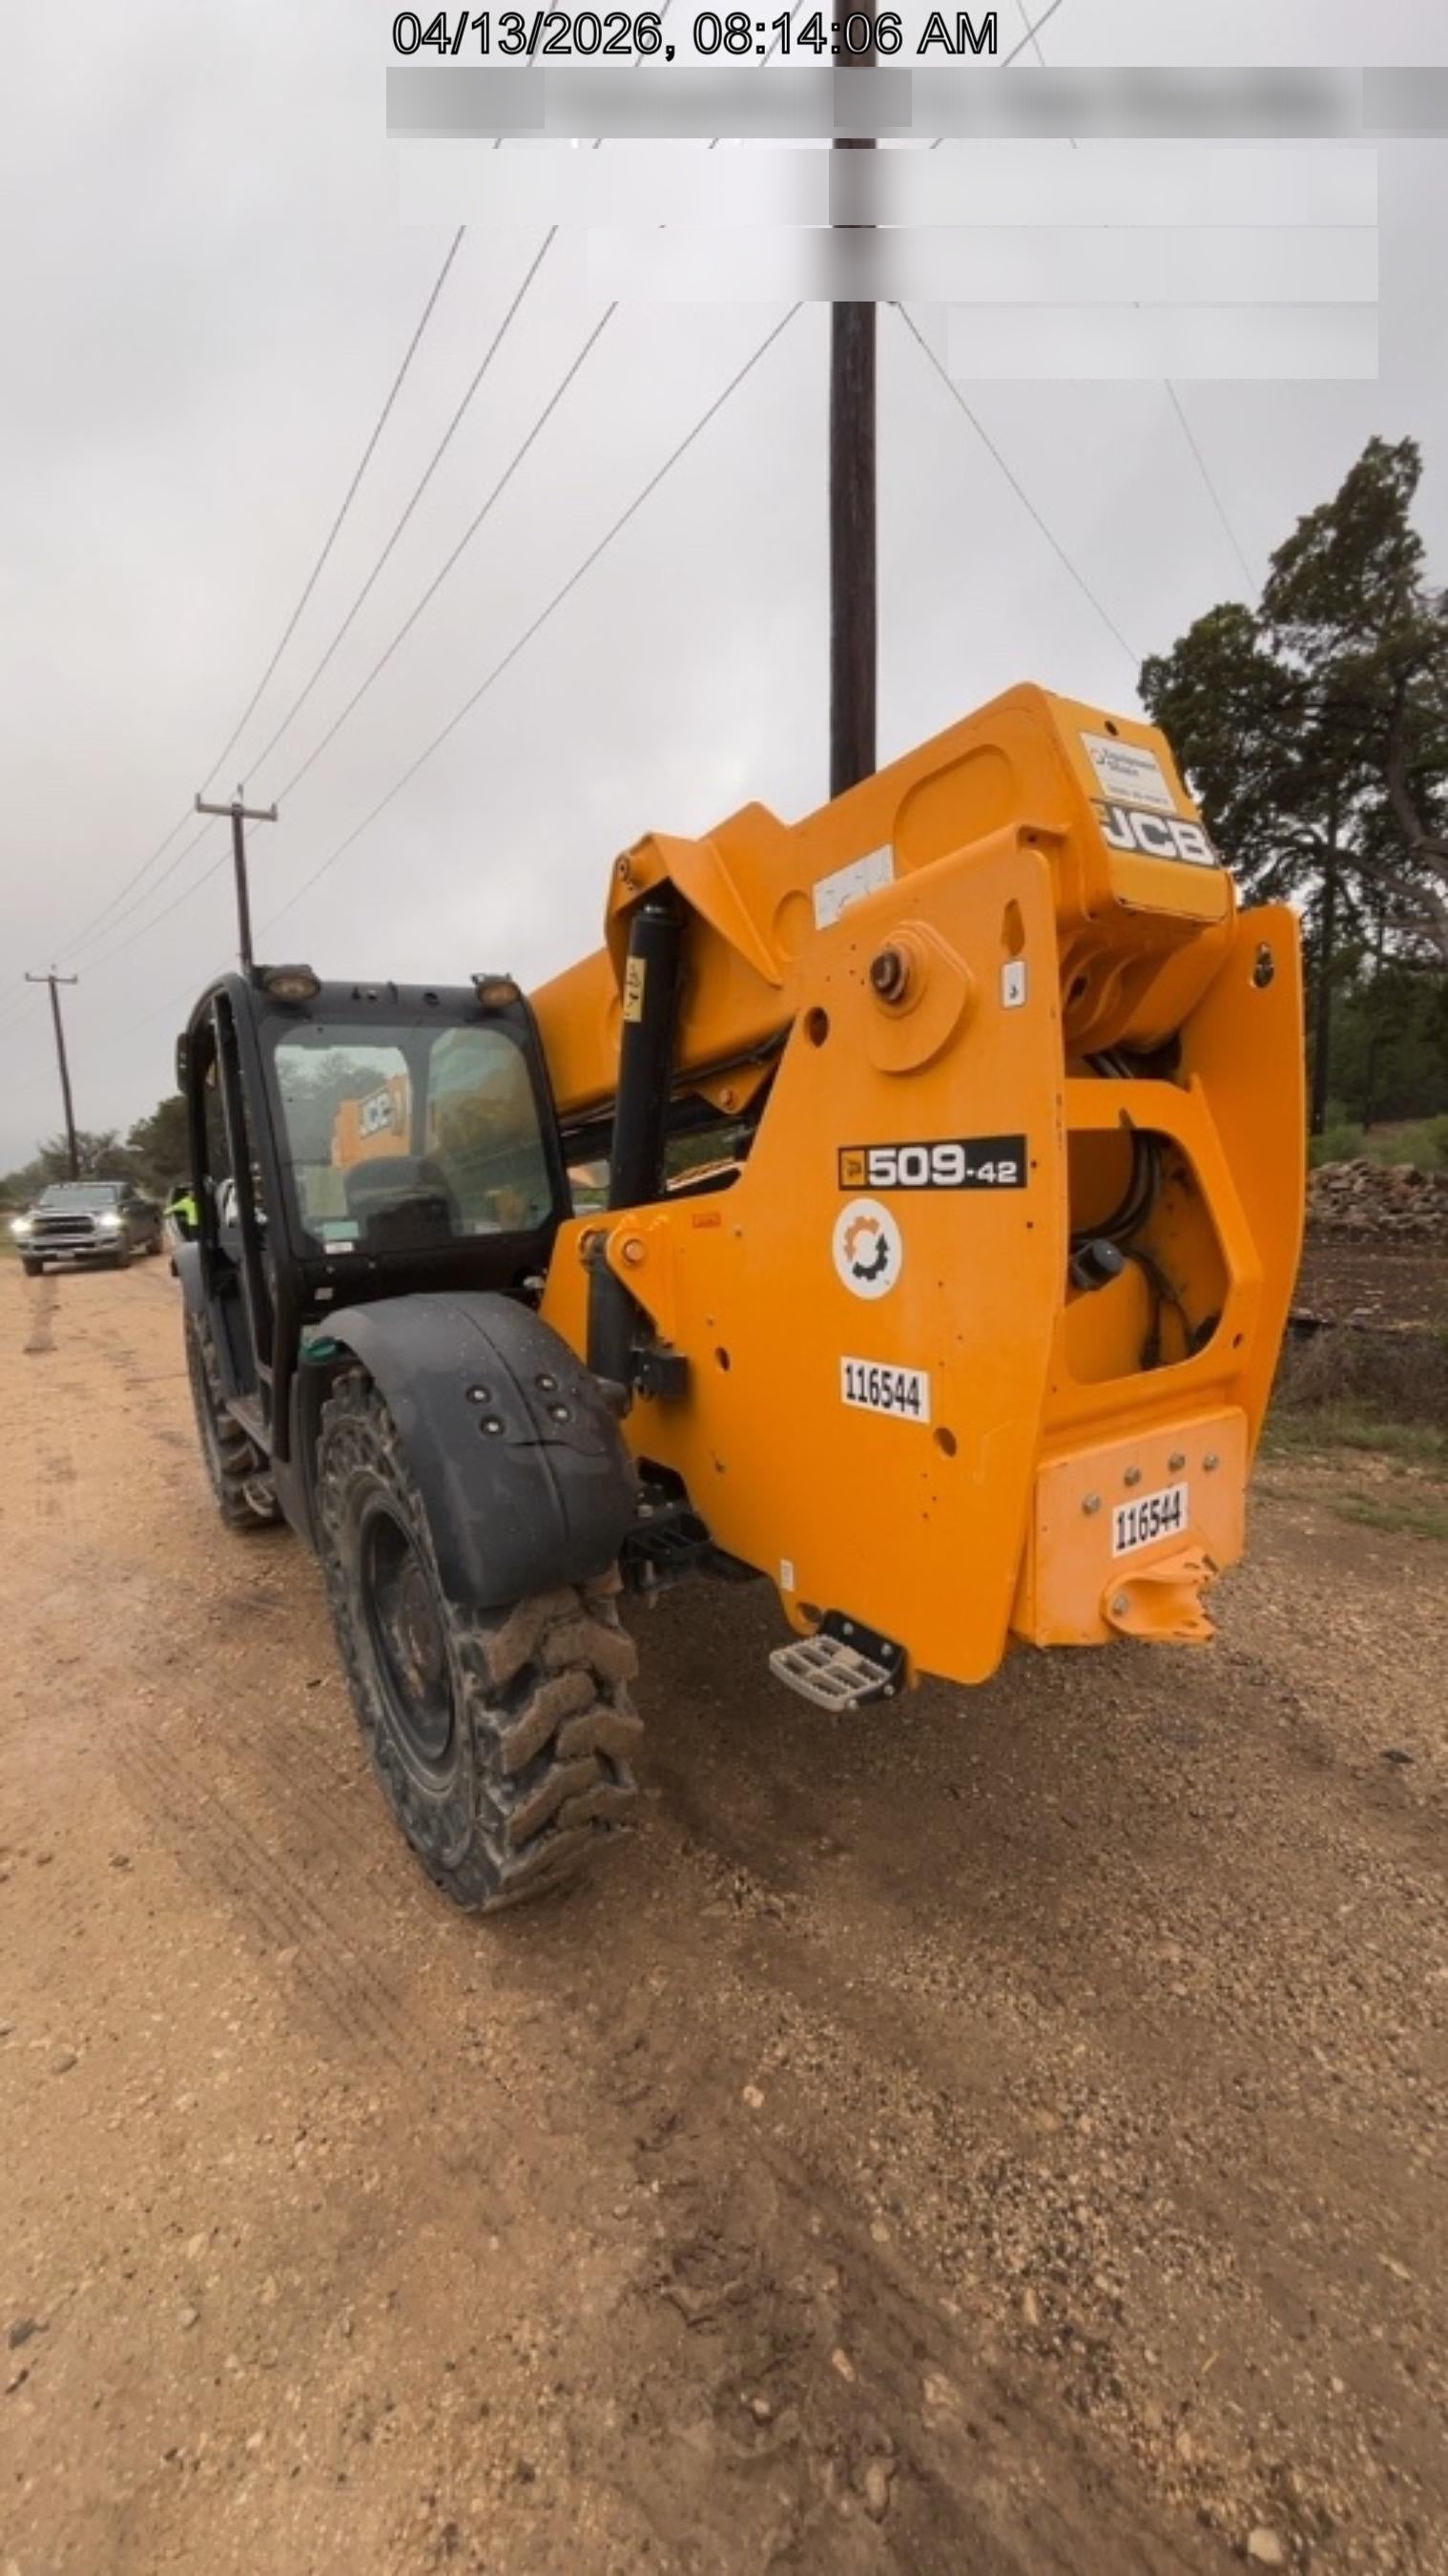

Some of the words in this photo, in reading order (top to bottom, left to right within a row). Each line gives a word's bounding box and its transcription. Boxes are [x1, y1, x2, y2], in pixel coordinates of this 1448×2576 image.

[1100, 806, 1214, 865] JCB
[868, 1144, 1018, 1186] 509-42
[845, 1363, 921, 1416] 116544
[1116, 1489, 1181, 1550] 116544
